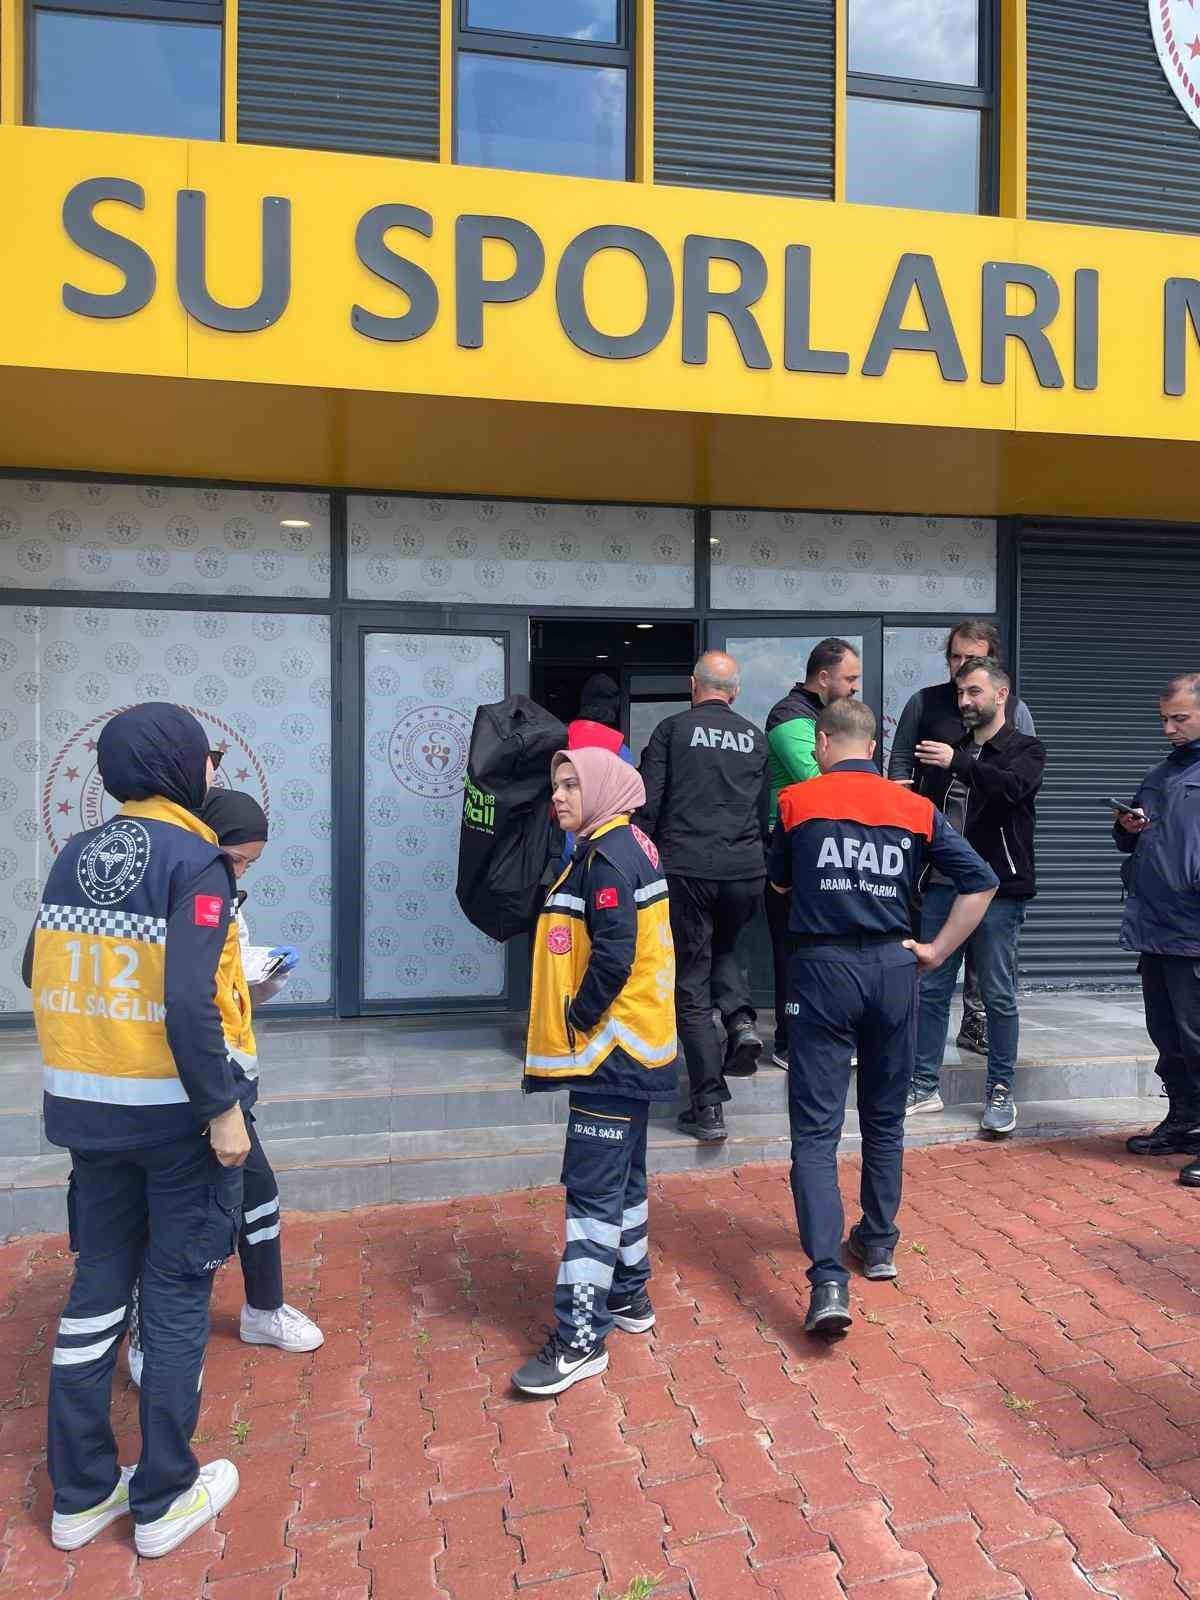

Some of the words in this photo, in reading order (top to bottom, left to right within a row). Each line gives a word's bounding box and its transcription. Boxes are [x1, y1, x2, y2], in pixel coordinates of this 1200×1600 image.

[62, 177, 291, 333] SU
[351, 203, 1099, 390] SPORLARI
[690, 726, 754, 754] AFAD
[816, 837, 904, 876] AFAD
[820, 878, 852, 891] ARAMA
[64, 940, 139, 989] 112
